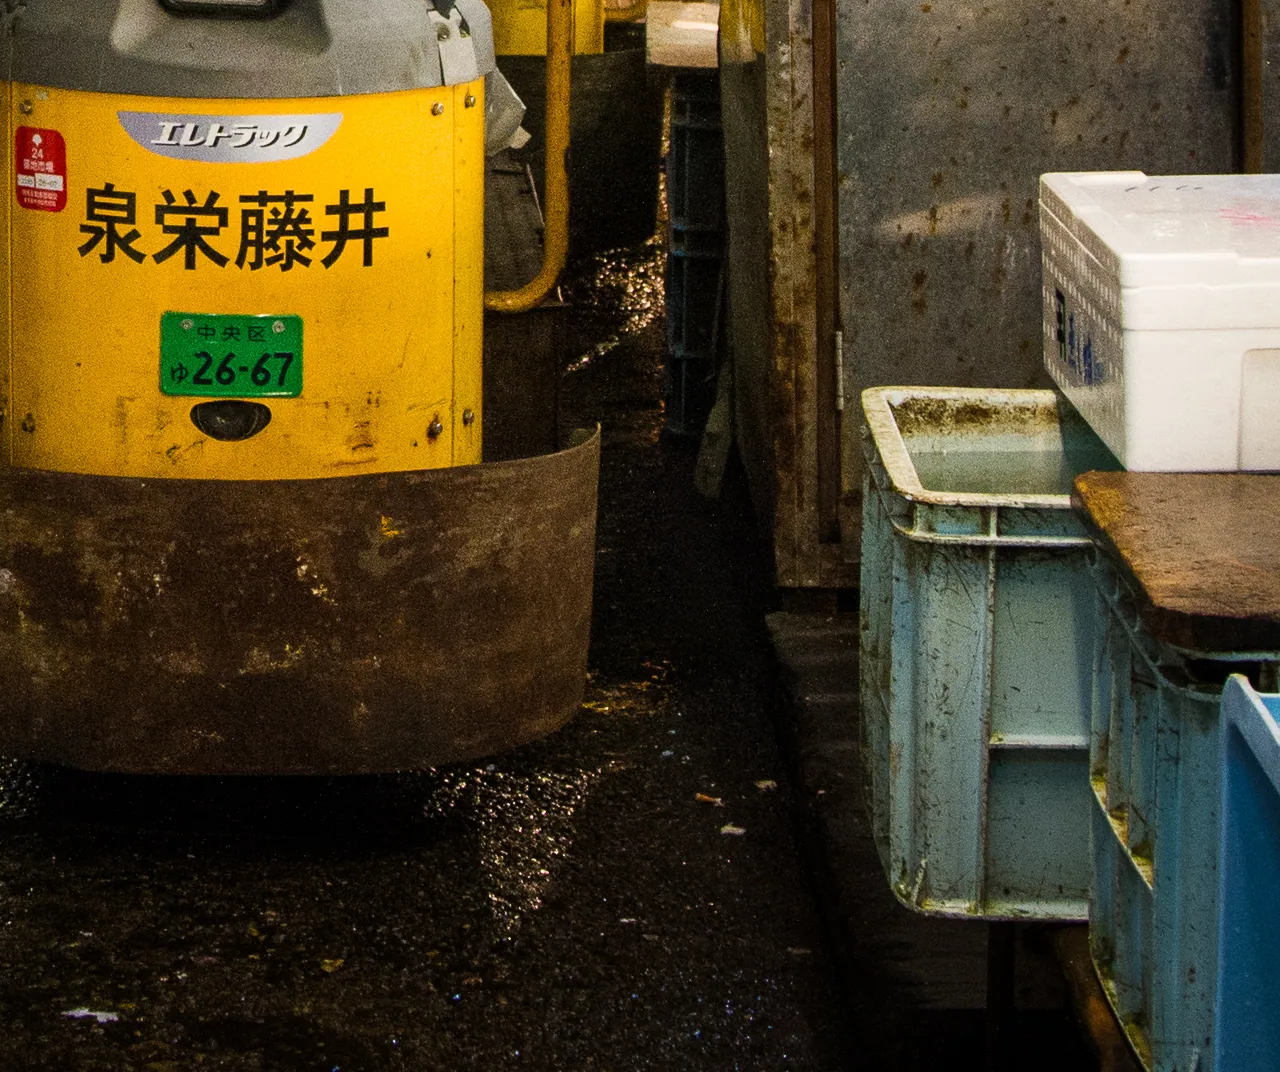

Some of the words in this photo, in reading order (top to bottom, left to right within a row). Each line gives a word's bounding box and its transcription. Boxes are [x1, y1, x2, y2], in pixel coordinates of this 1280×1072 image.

[151, 121, 308, 148] エレトラック
[77, 182, 389, 272] 泉栄藤井
[197, 323, 267, 343] 中央区
